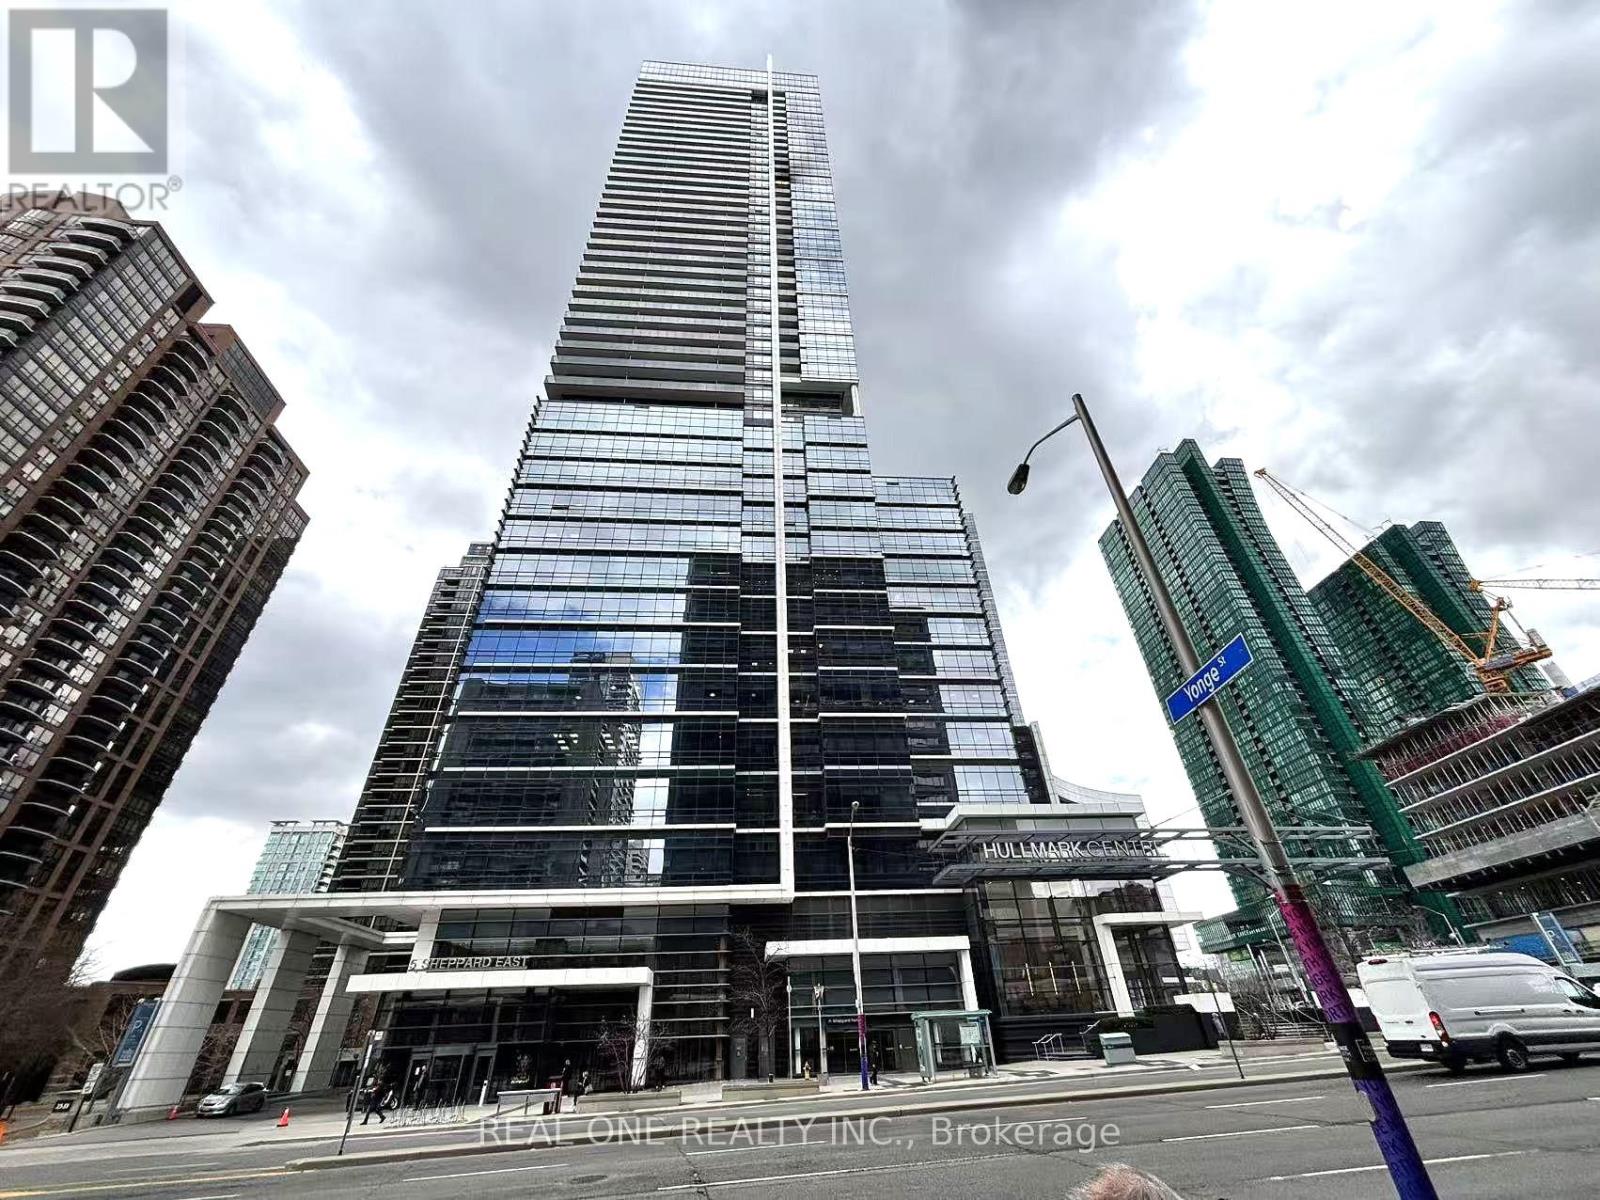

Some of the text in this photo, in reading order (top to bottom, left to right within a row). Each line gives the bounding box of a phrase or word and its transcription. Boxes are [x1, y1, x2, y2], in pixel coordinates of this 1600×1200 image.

[1183, 655, 1227, 702] Yonge St
[983, 839, 1166, 859] HULLMARK CENTRE
[408, 955, 528, 971] 5 SHEPPARD EAST
